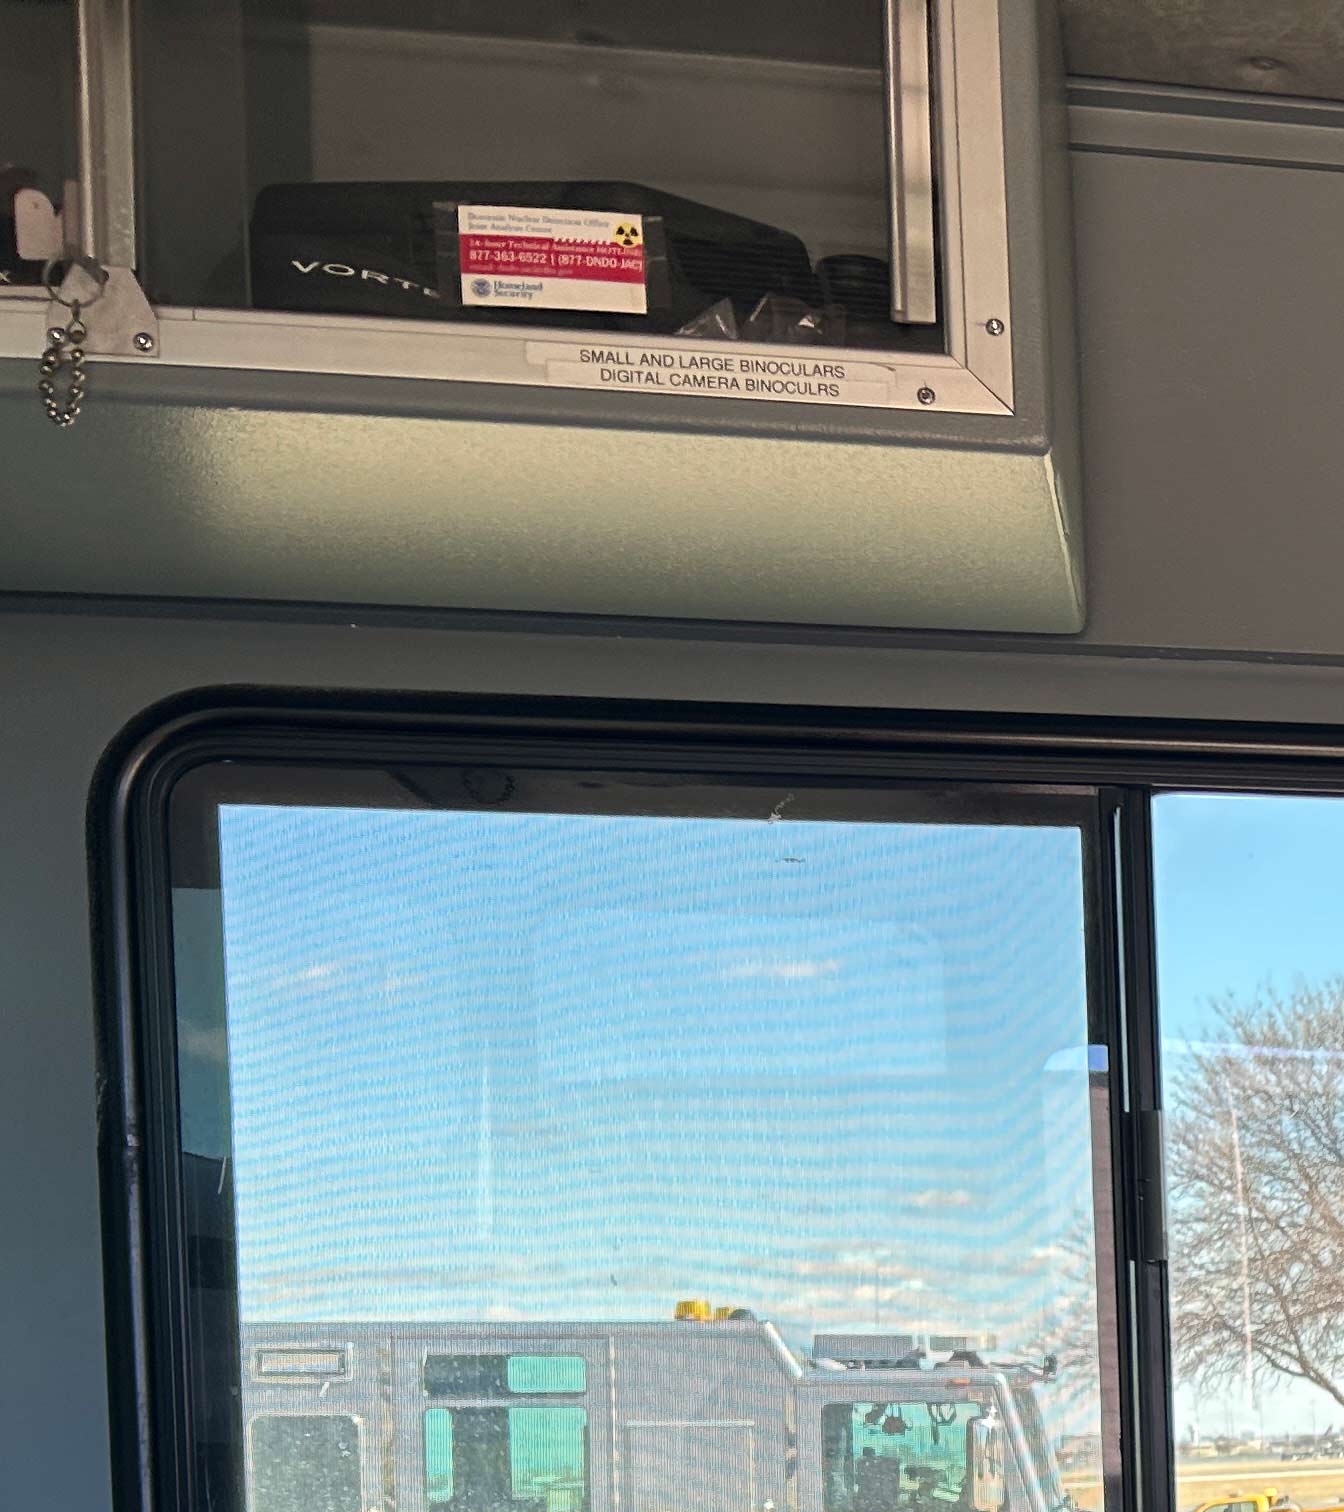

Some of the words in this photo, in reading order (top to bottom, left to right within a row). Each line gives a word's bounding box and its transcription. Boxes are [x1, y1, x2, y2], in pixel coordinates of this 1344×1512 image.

[580, 348, 635, 366] SMALL
[639, 353, 675, 369] AND
[678, 355, 735, 373] LARGE
[739, 359, 847, 380] BINOCULARS
[599, 368, 665, 386] DIGITAL
[668, 372, 741, 392] CAMERA
[744, 379, 841, 398] BINOCULRS
